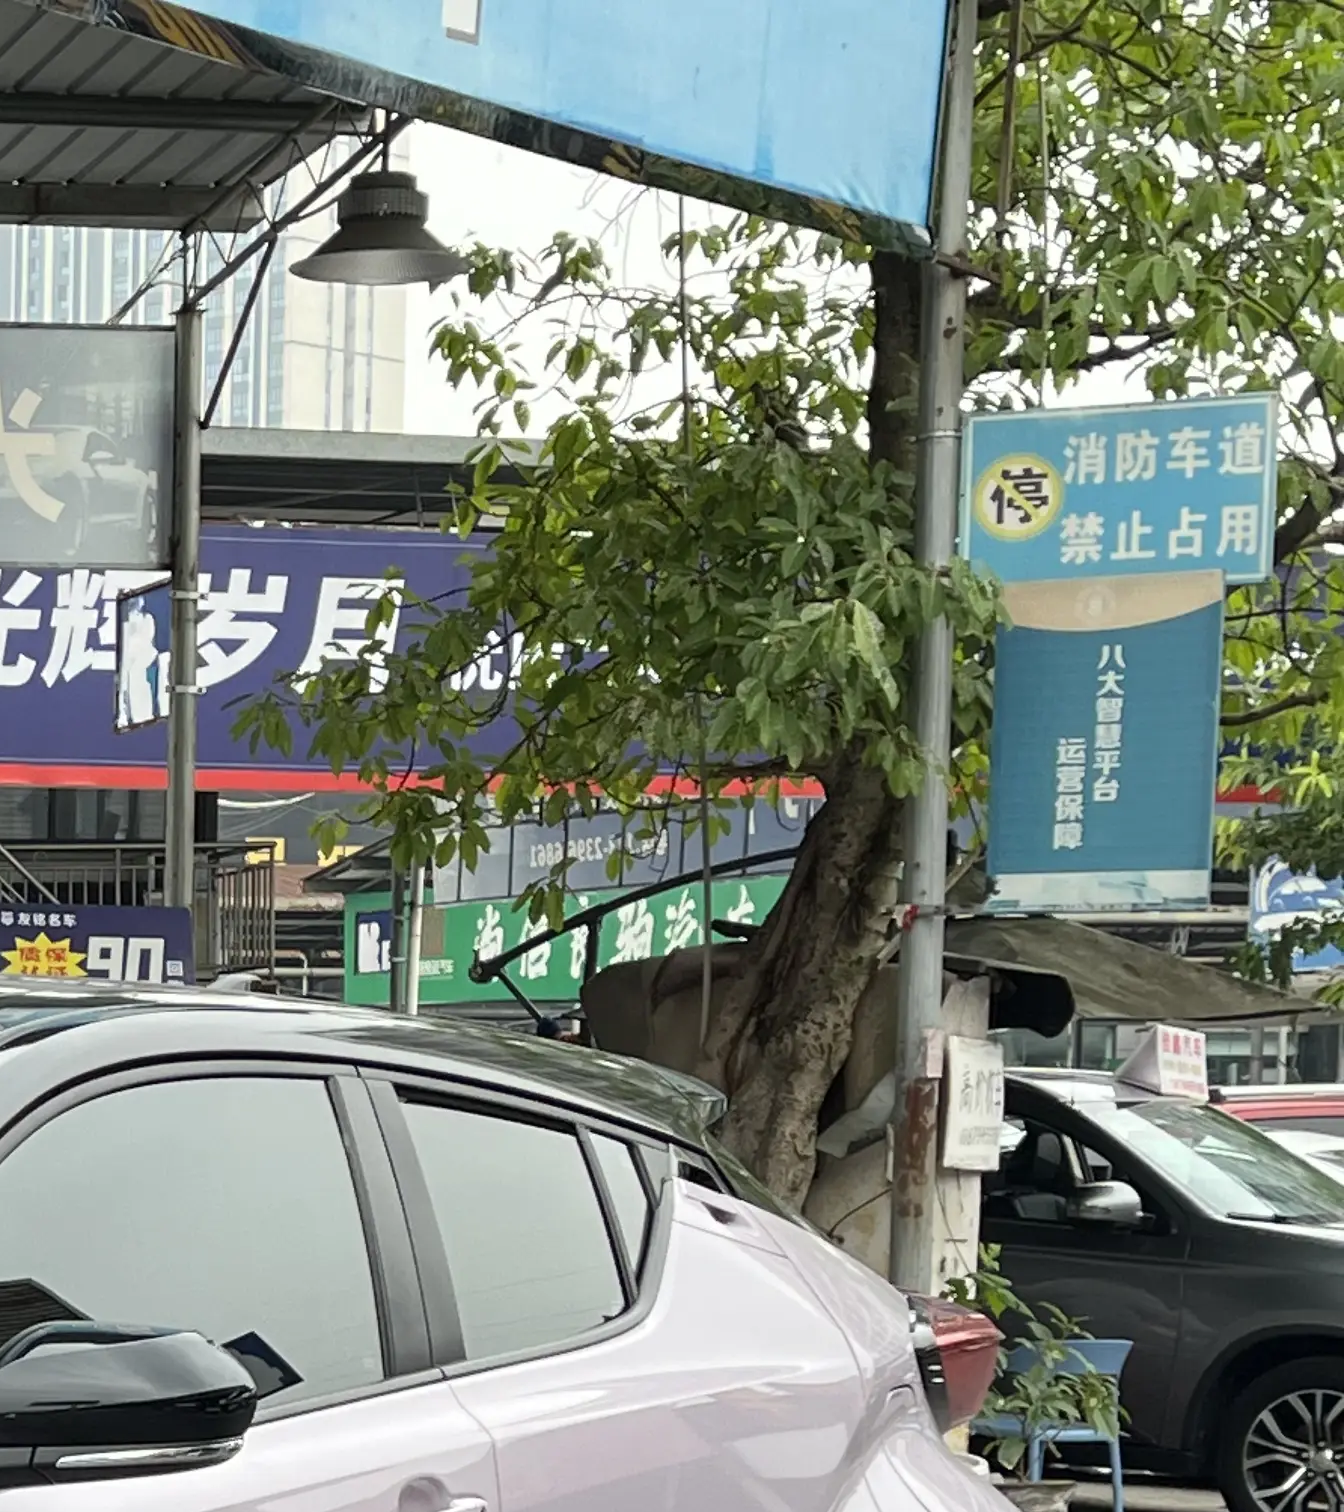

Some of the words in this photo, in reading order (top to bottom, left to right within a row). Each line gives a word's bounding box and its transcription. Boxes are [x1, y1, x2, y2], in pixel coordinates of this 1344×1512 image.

[1063, 422, 1265, 485] 消防车道
[990, 466, 1049, 525] 停
[1059, 504, 1260, 565] 禁止占用
[1092, 644, 1128, 801] 八大智慧平台
[1052, 737, 1087, 850] 运营保障
[86, 936, 165, 985] 90
